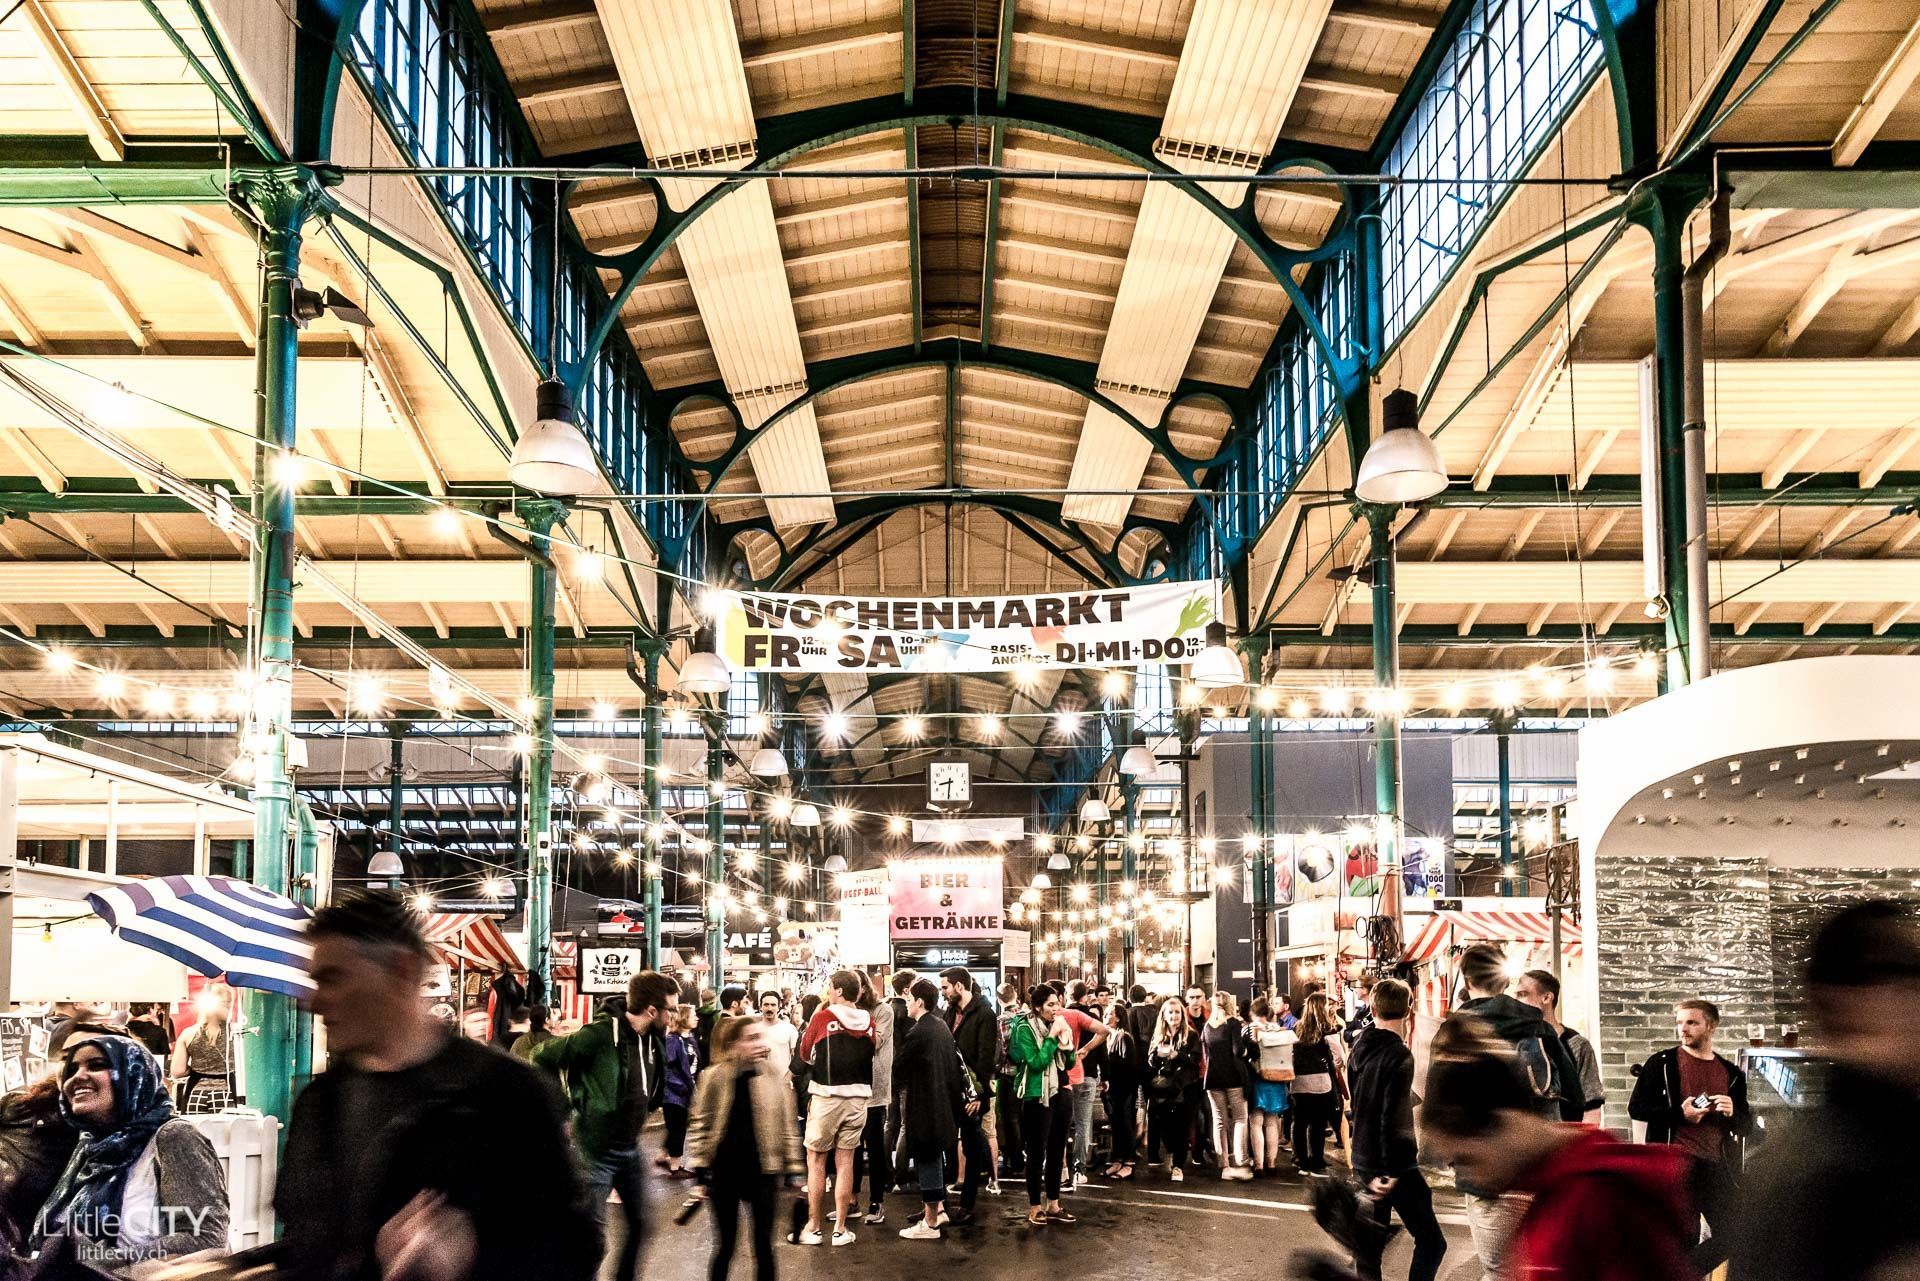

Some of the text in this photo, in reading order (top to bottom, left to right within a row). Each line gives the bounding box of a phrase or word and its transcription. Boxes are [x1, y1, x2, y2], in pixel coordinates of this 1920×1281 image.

[741, 592, 1130, 629] WOCHENMARKT
[744, 635, 801, 667] FR
[801, 646, 827, 655] UHR
[837, 635, 901, 667] SA
[901, 646, 926, 654] UHR
[991, 644, 1032, 653] BASIS-
[920, 874, 969, 888] BIER
[940, 894, 953, 907] &
[895, 911, 998, 930] GETRÄNKE
